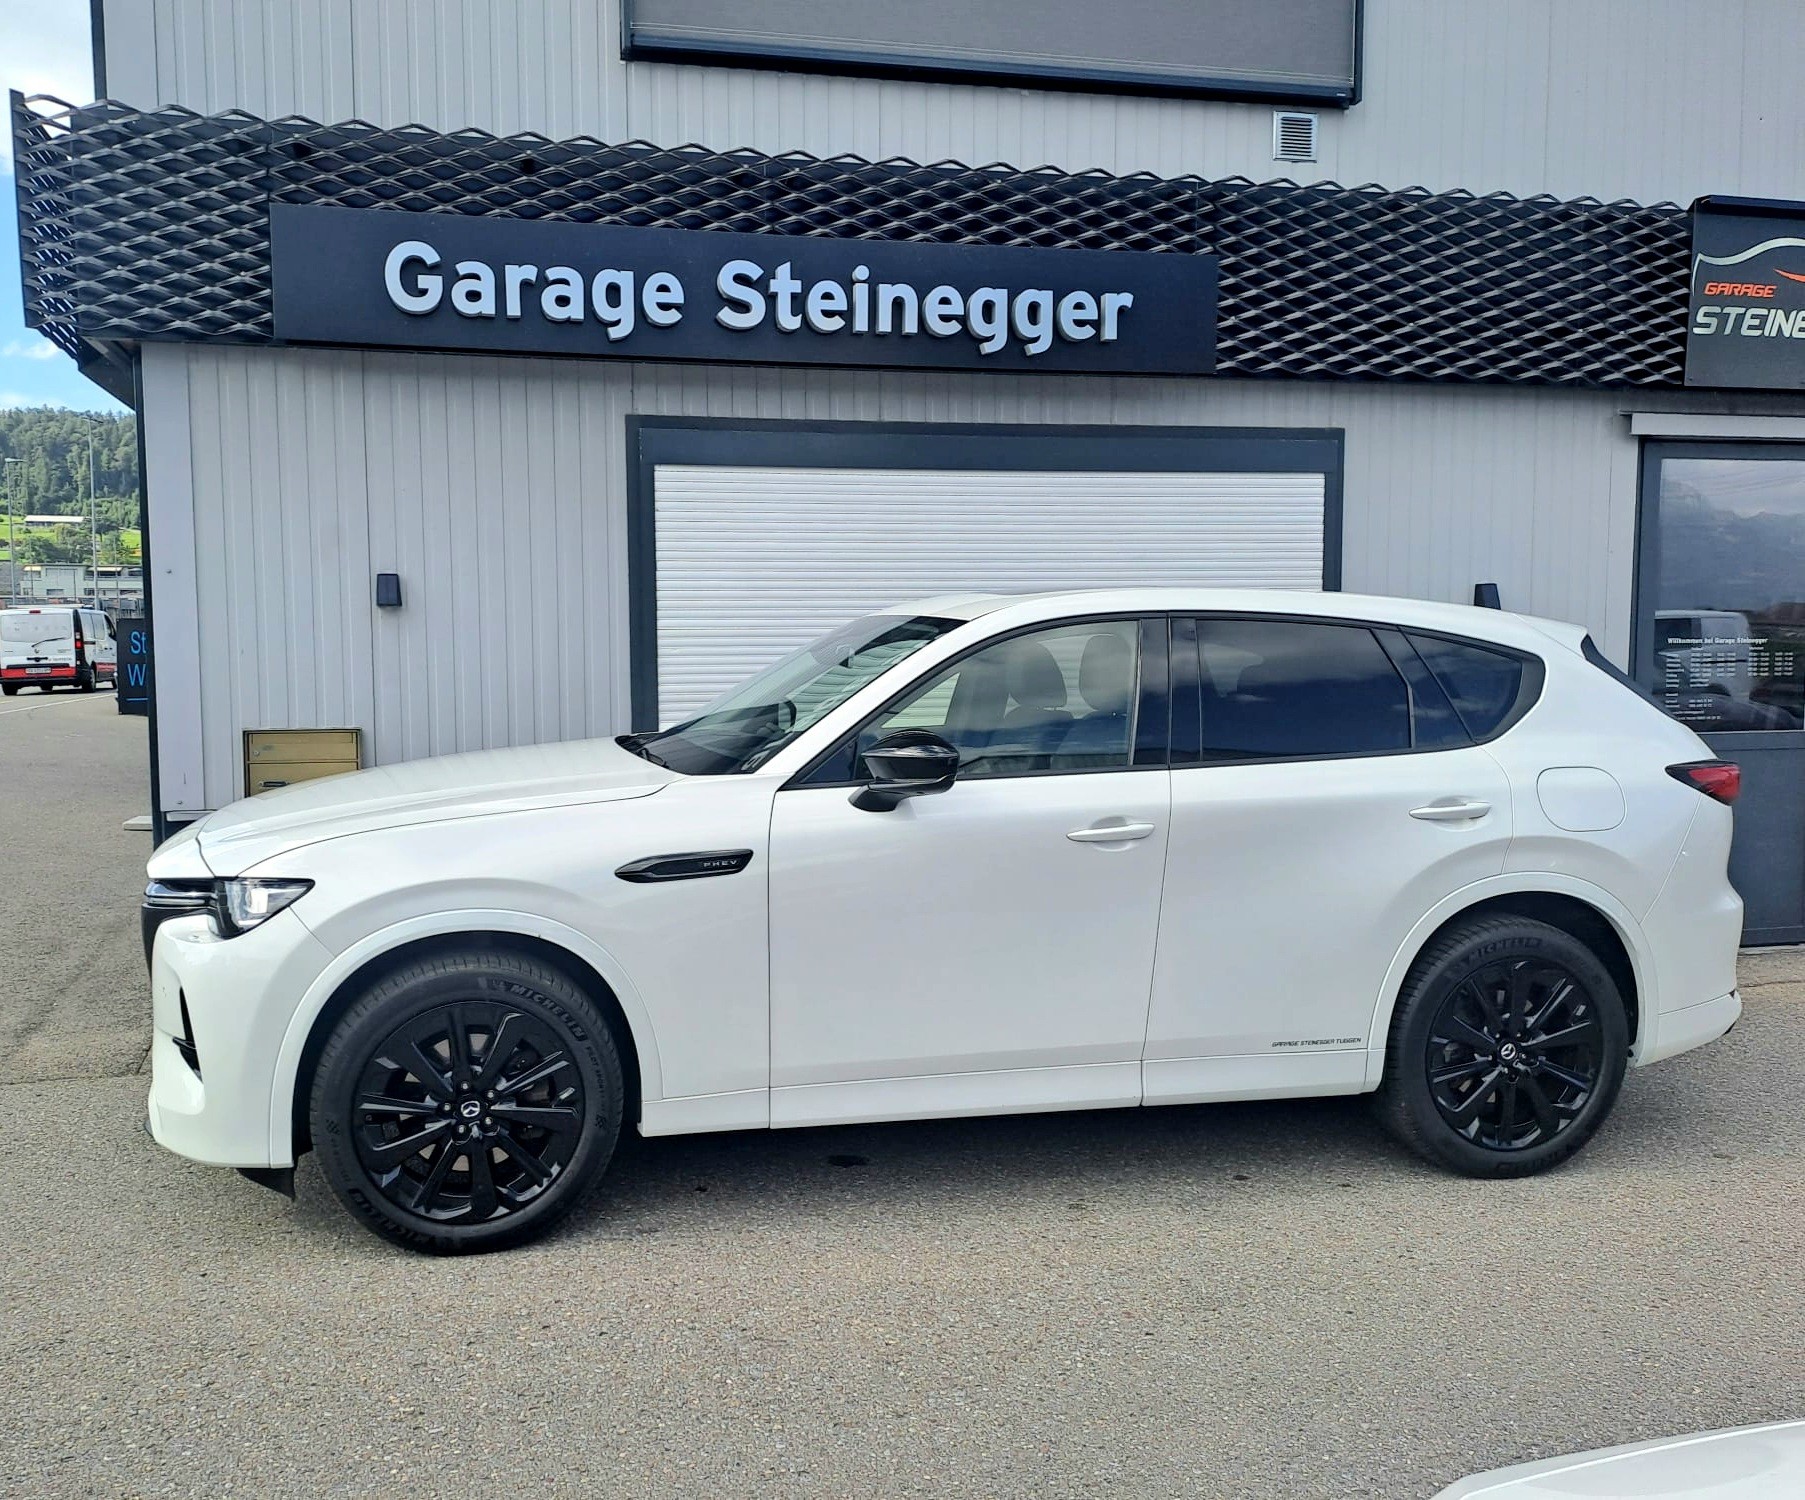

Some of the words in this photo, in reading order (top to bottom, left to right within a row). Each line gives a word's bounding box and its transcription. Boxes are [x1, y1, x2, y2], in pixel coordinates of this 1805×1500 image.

[384, 240, 685, 342] Garage
[715, 259, 1134, 356] Steinegger
[1704, 282, 1777, 298] GARAGE
[1715, 637, 1735, 645] Garage
[509, 982, 588, 1042] MICHELIN
